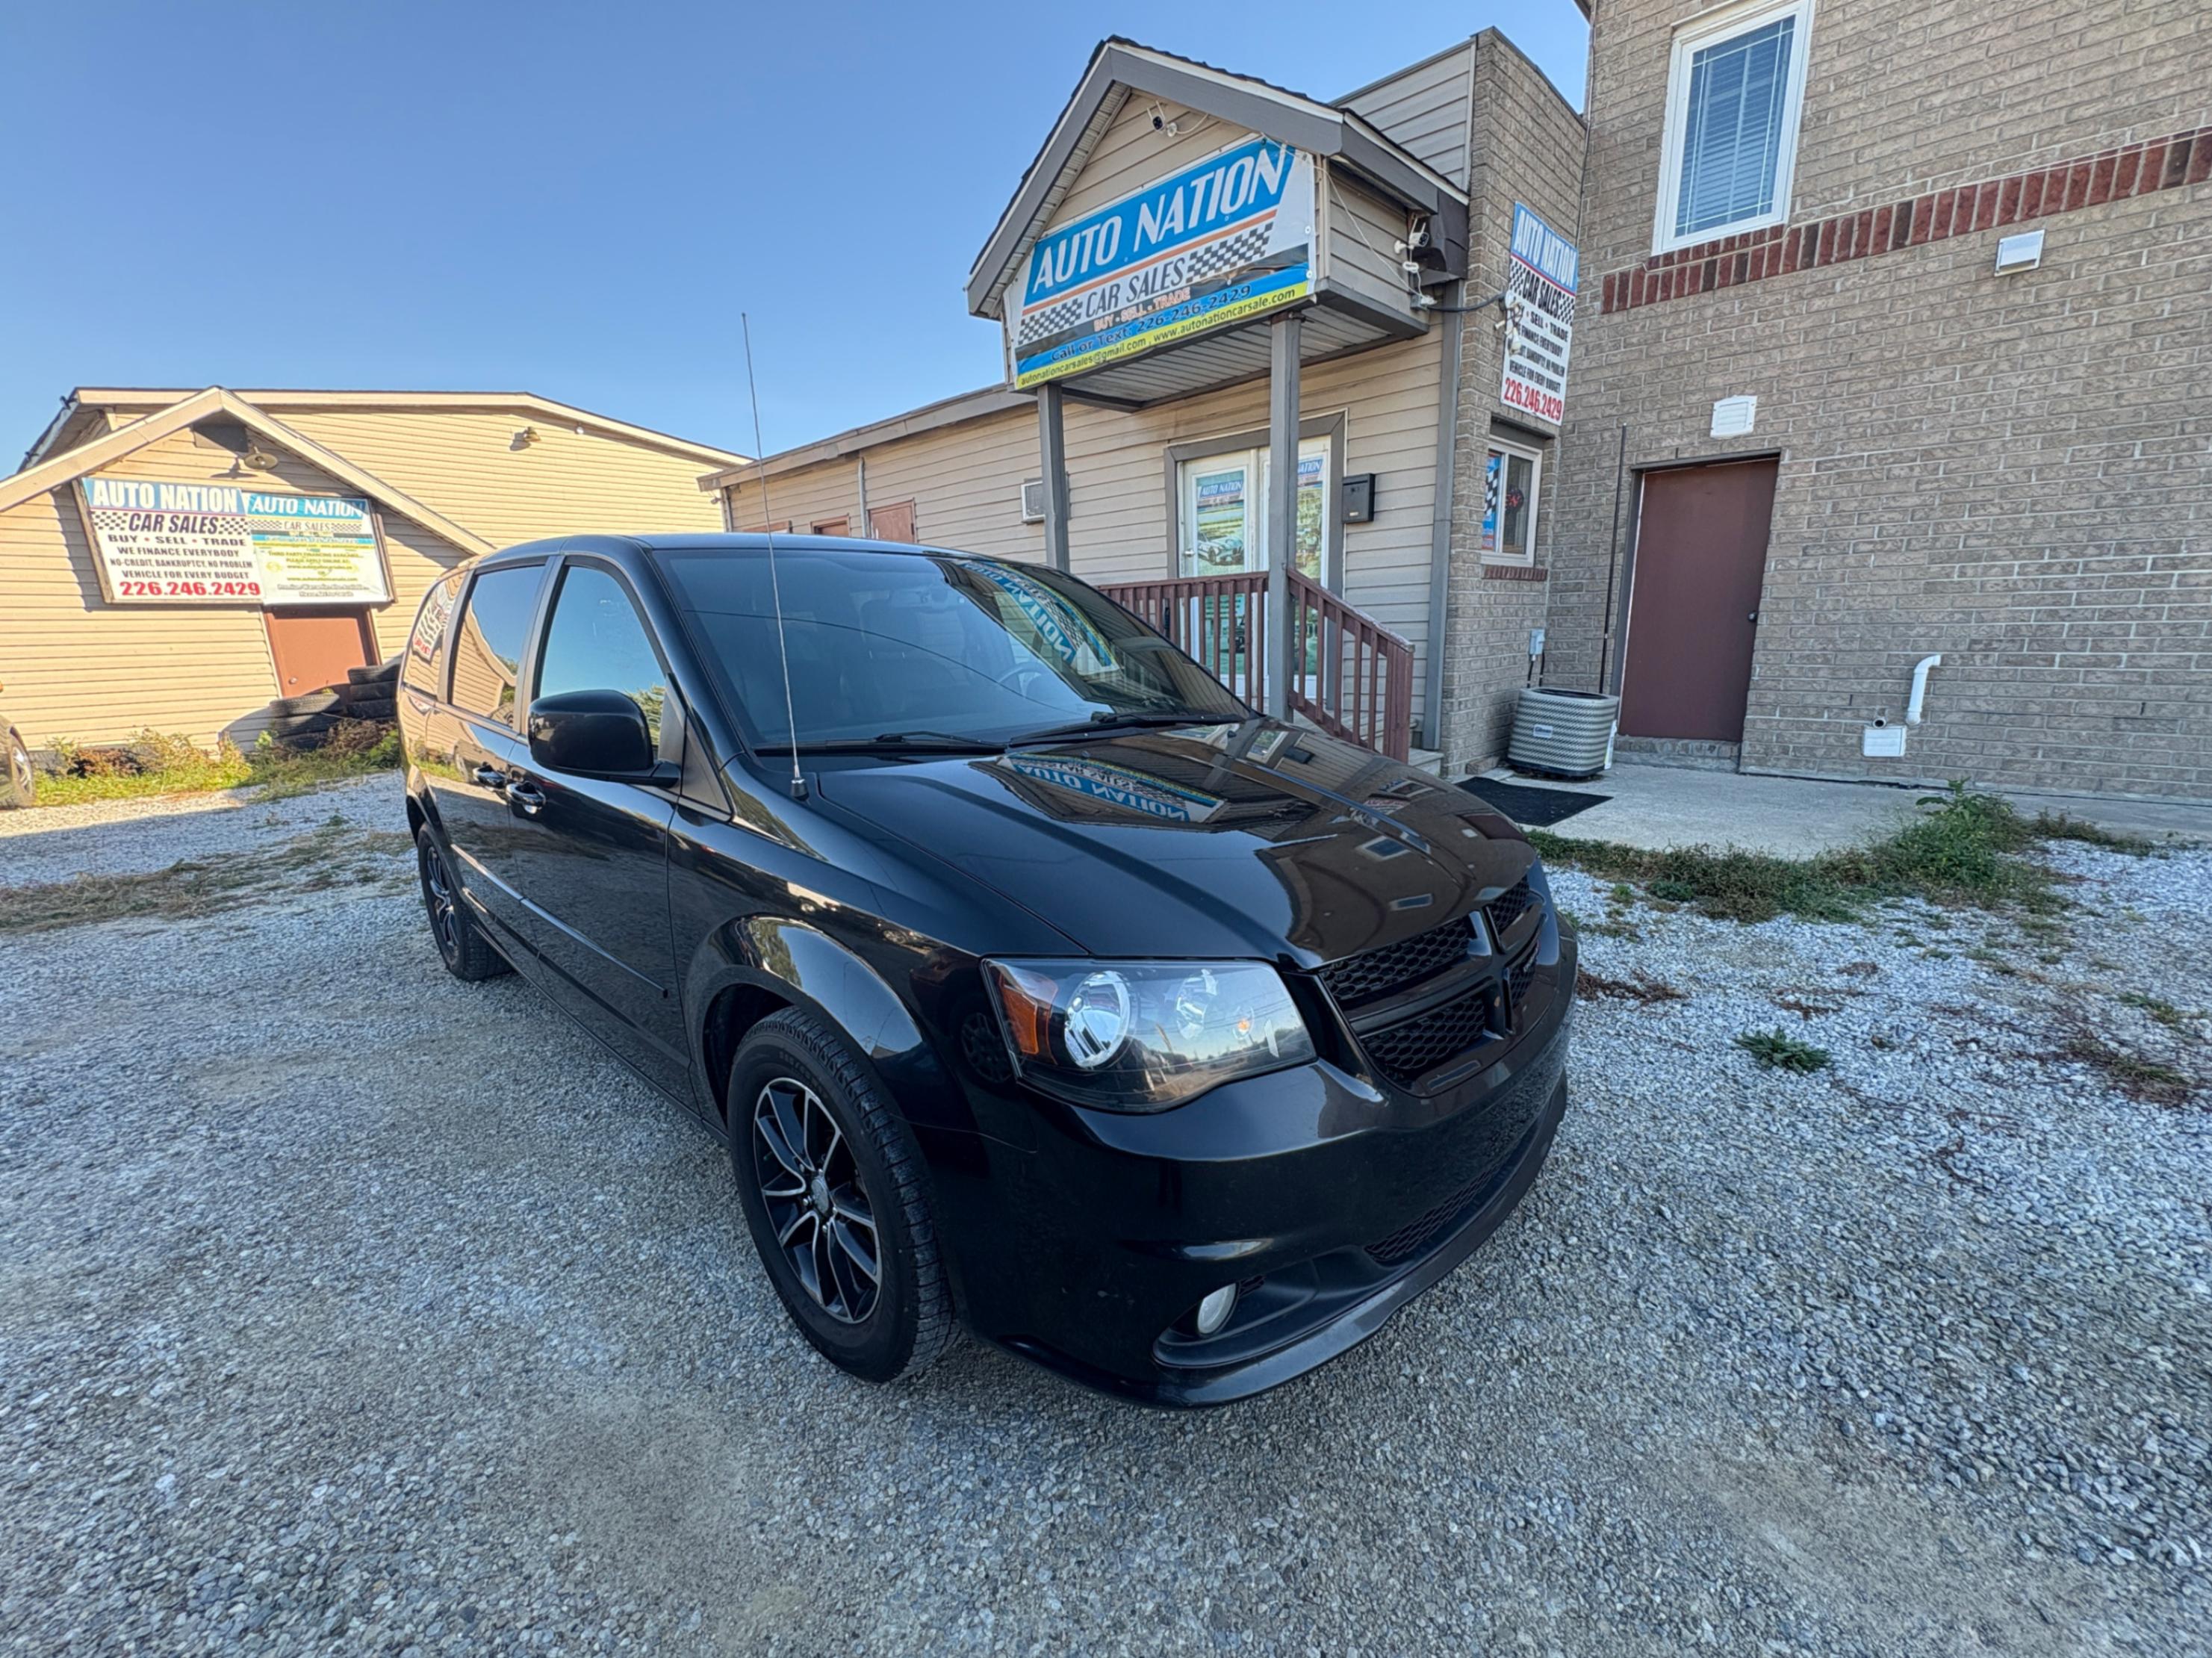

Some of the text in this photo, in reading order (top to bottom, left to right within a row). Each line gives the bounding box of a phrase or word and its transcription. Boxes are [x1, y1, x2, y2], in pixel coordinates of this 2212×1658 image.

[1033, 144, 1286, 293] AUTO NATION
[1514, 210, 1576, 288] AUTO NATION
[1086, 257, 1185, 317] CAR SALES
[1523, 270, 1540, 306] CAR
[1538, 280, 1562, 318] SALES
[1051, 344, 1075, 361] Call
[1078, 341, 1093, 353] or
[1137, 285, 1250, 332] 226-246-2429
[1093, 287, 1190, 332] BUY SELL TRADE
[1531, 311, 1543, 329] SELL
[1550, 322, 1568, 342] TRADE
[1021, 288, 1295, 385] autonationcarsales@gmail.com www.autonationcarsale.com
[1504, 377, 1562, 421] 226.246.2429
[93, 479, 237, 513] AUTO NATION
[251, 496, 364, 518] AUTO NATION
[108, 534, 137, 543] BUY
[155, 536, 187, 544] SELL
[202, 538, 246, 546] TRADE
[128, 513, 219, 534] CAR SALES
[285, 521, 329, 531] CAR SALES
[117, 547, 239, 557] WE FINANCE EVERYBODY
[119, 581, 261, 596] 226.246.2429
[122, 570, 249, 580] VEHICLE FOR EVERY BUDGET
